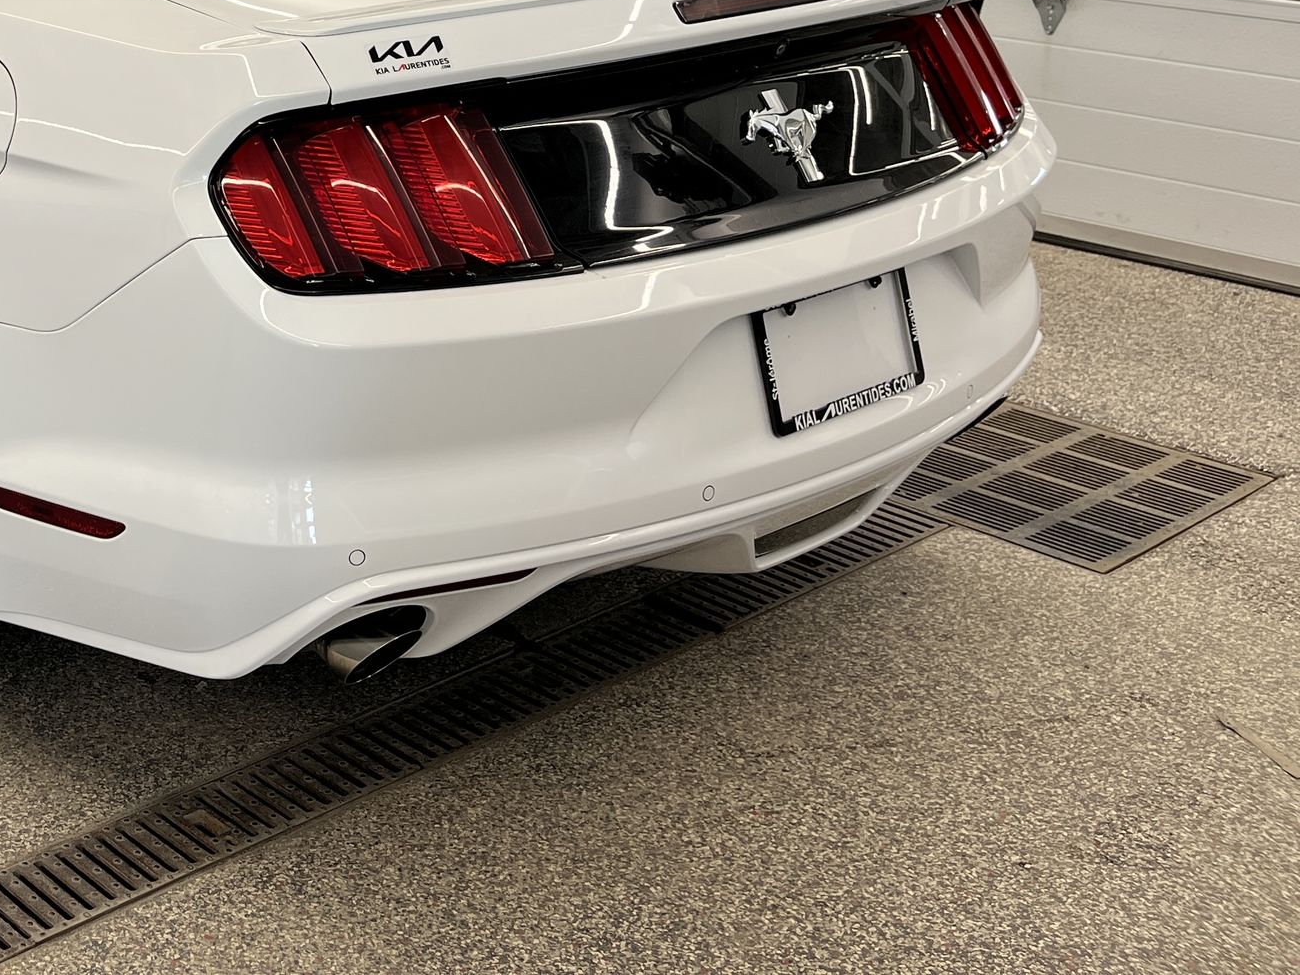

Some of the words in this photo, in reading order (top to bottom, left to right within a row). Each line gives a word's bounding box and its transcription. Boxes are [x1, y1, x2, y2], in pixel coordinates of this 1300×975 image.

[368, 35, 444, 63] KIA
[375, 66, 390, 75] KIA
[392, 57, 450, 73] LAURENTIDES
